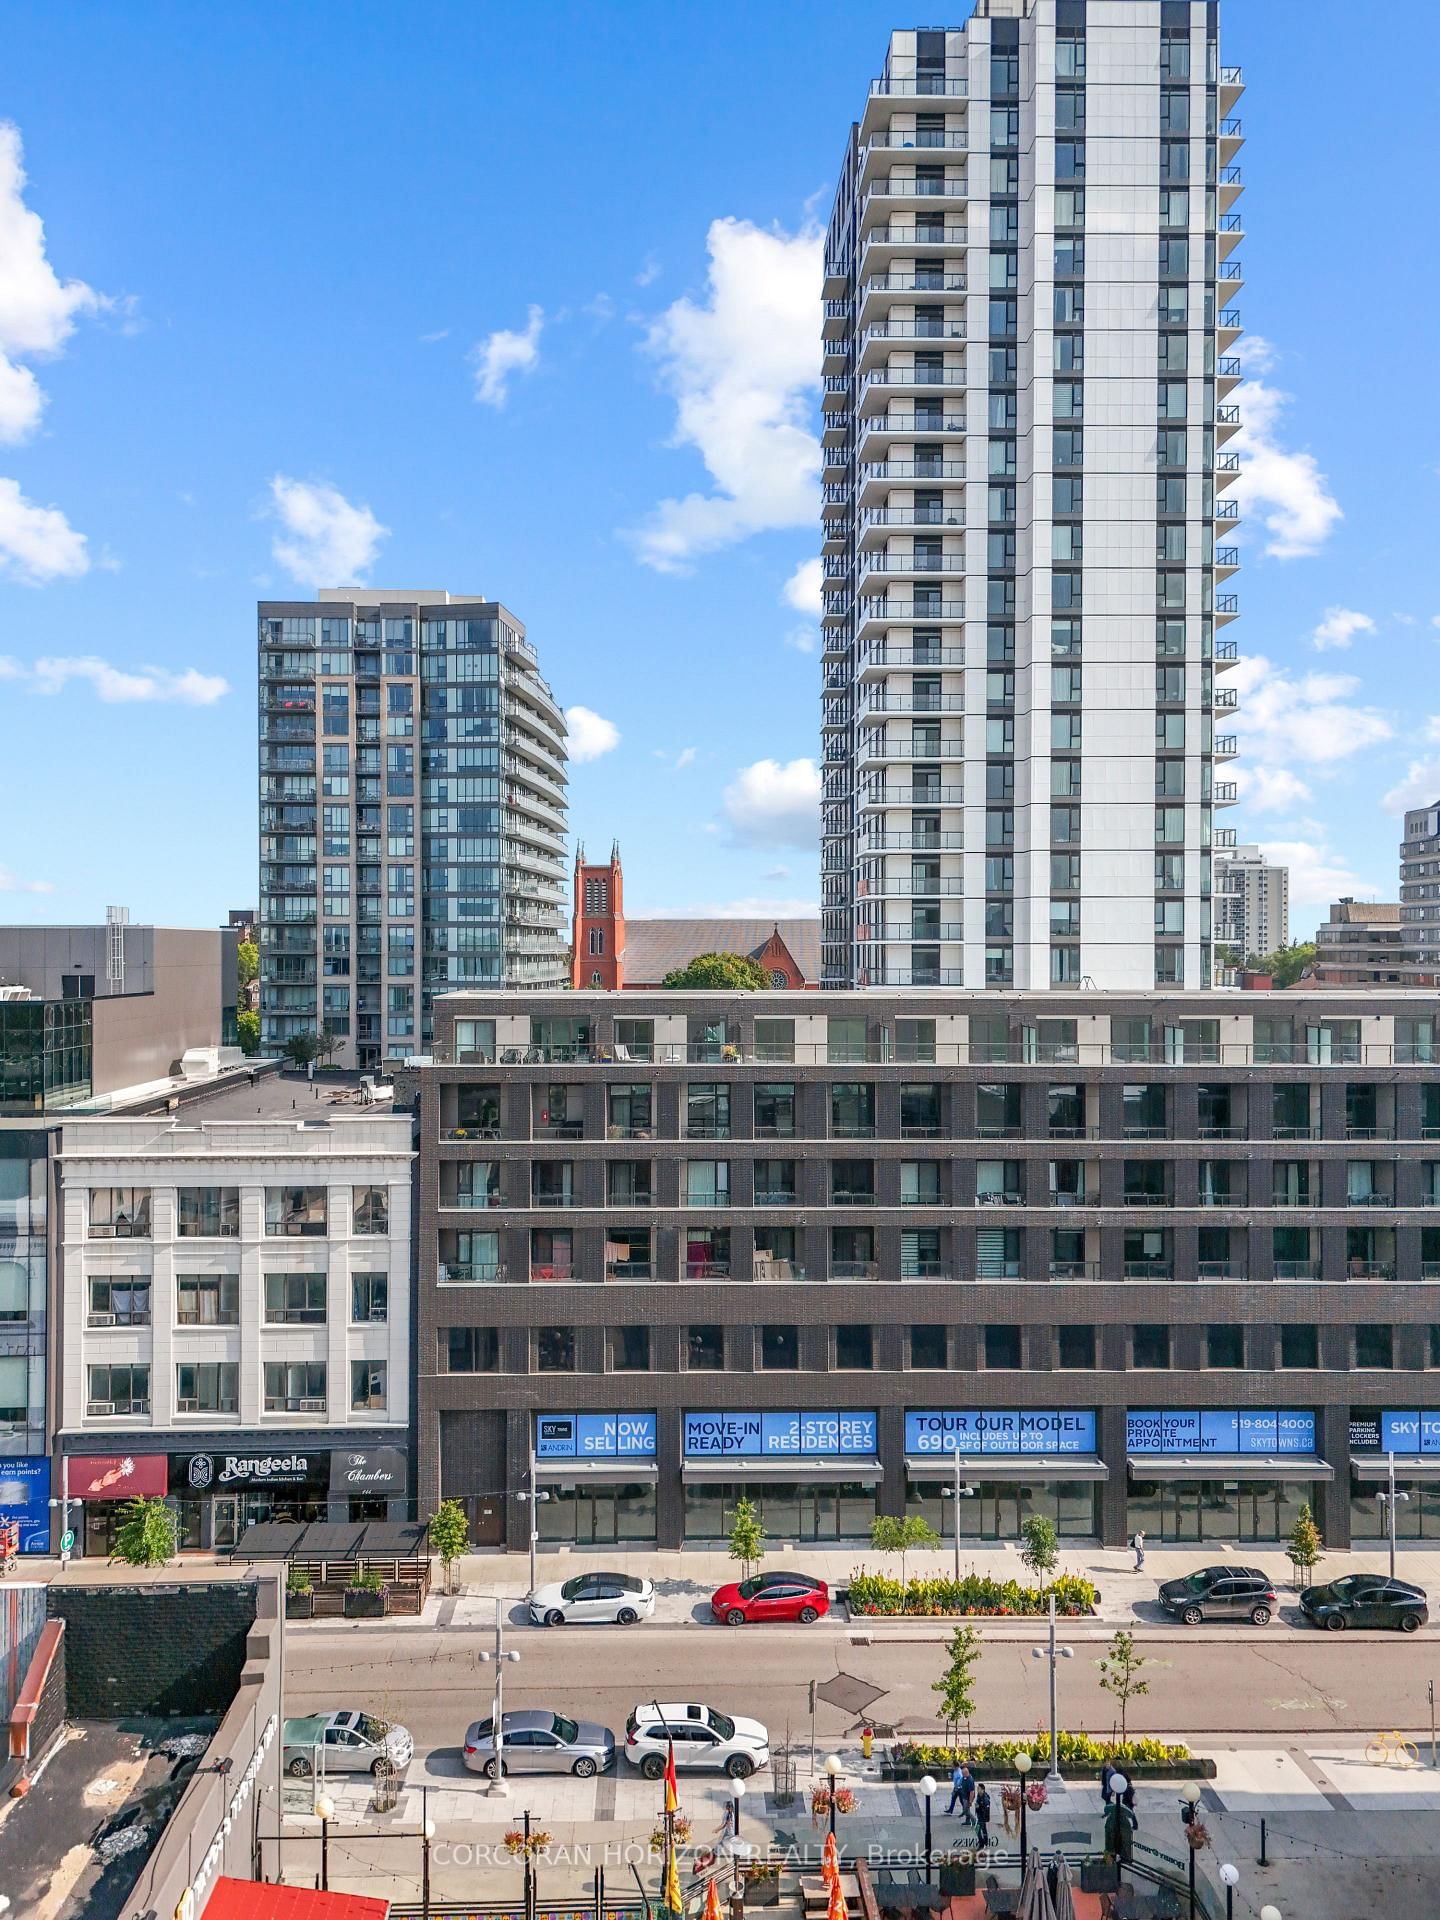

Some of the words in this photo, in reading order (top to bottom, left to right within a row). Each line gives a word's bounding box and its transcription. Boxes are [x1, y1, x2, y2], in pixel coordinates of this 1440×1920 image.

[544, 1425, 556, 1433] SKY
[604, 1422, 648, 1436] NOW
[688, 1422, 760, 1435] MOVE-IN
[789, 1420, 873, 1435] 2-STOREY
[916, 1417, 967, 1431] TOUR
[975, 1417, 1013, 1431] OUR
[1021, 1417, 1086, 1431] MODEL
[1128, 1419, 1160, 1428] BOOK
[1163, 1419, 1195, 1428] YOUR
[1231, 1419, 1314, 1429] 519-804-4000
[960, 1432, 1008, 1441] INCLUDES
[1013, 1432, 1028, 1441] UP
[1030, 1432, 1043, 1441] TO
[1128, 1428, 1177, 1438] PRIVATE
[584, 1437, 655, 1450] SELLING
[688, 1436, 745, 1450] READY
[768, 1435, 873, 1449] RESIDENCES
[918, 1434, 956, 1450] 690
[960, 1441, 972, 1449] SF
[973, 1441, 987, 1449] OF
[990, 1441, 1043, 1449] OUTDOOR
[1045, 1441, 1079, 1449] SPACE
[1127, 1438, 1218, 1448] APPOINTMENT
[347, 1454, 367, 1466] The
[17, 1468, 41, 1477] points?
[218, 1455, 308, 1482] Rangeela
[343, 1468, 394, 1484] Chambers
